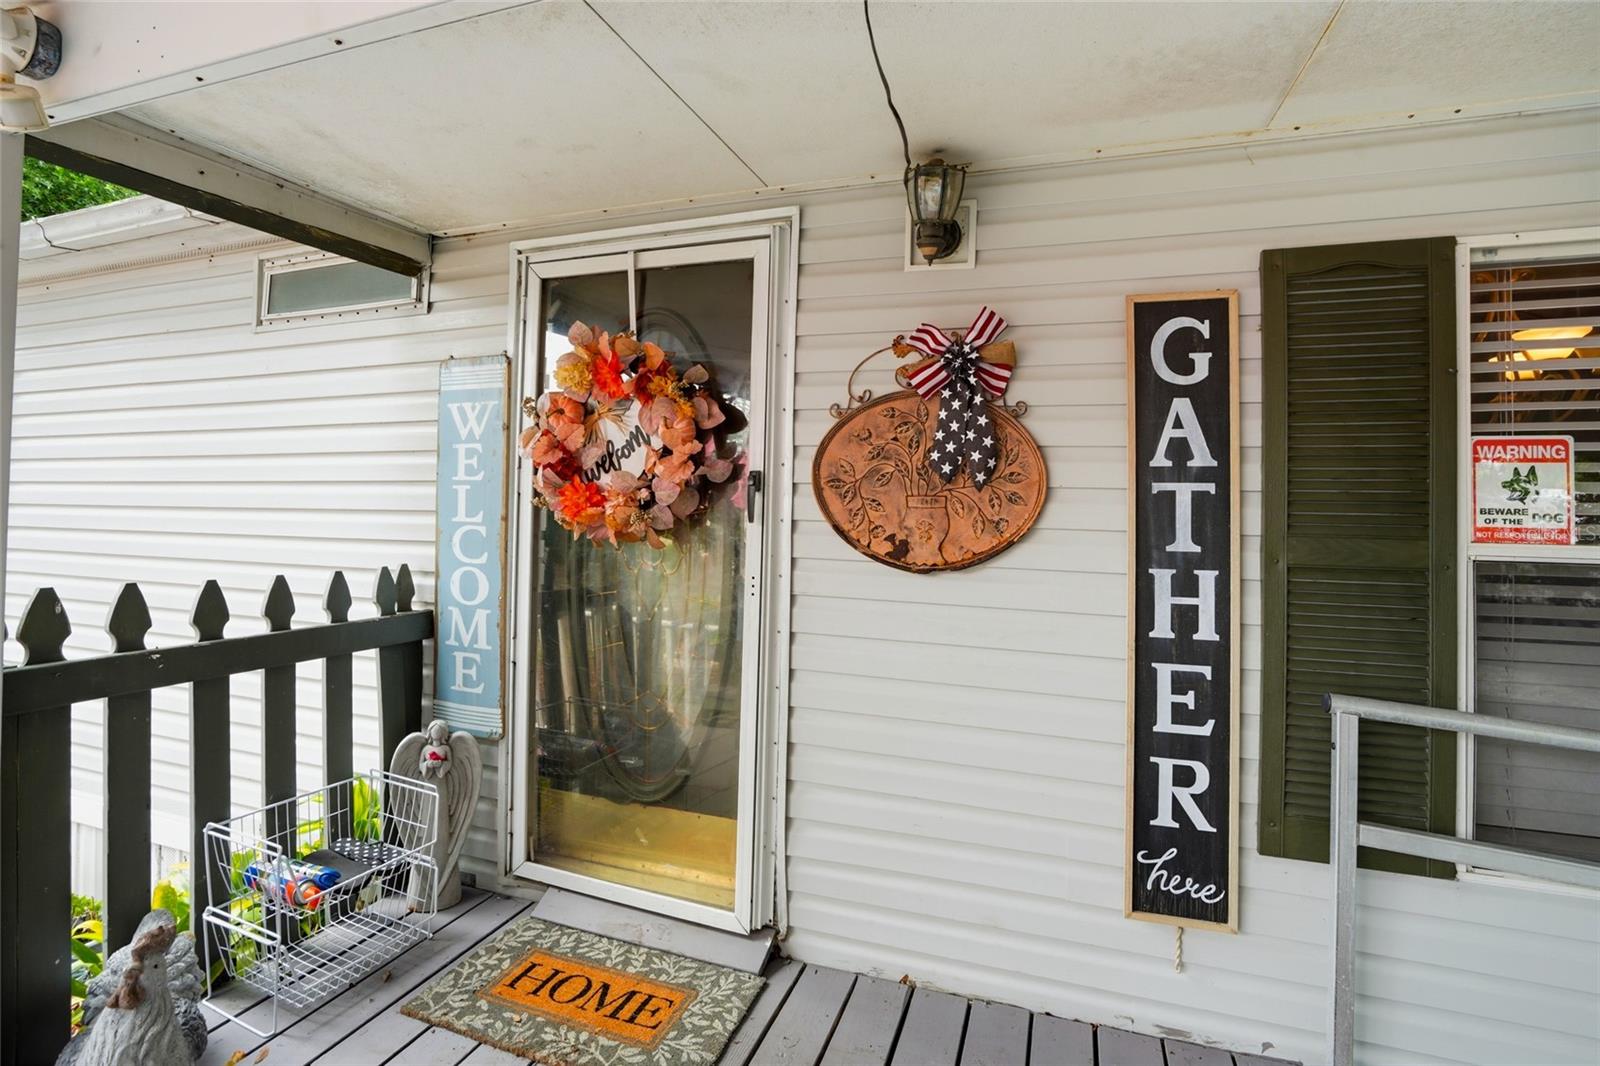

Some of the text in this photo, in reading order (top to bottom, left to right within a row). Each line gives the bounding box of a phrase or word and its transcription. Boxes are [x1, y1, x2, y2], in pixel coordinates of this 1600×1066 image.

[584, 424, 652, 483] welcom
[1477, 445, 1566, 459] WARNING
[1480, 507, 1529, 516] BEWARE
[1501, 518, 1524, 526] THE
[1532, 513, 1565, 524] DOG
[445, 401, 498, 695] WELCOME
[1476, 531, 1492, 539] NOT
[1149, 317, 1220, 832] GATHER
[1137, 848, 1225, 904] here
[505, 960, 675, 1031] HOME
